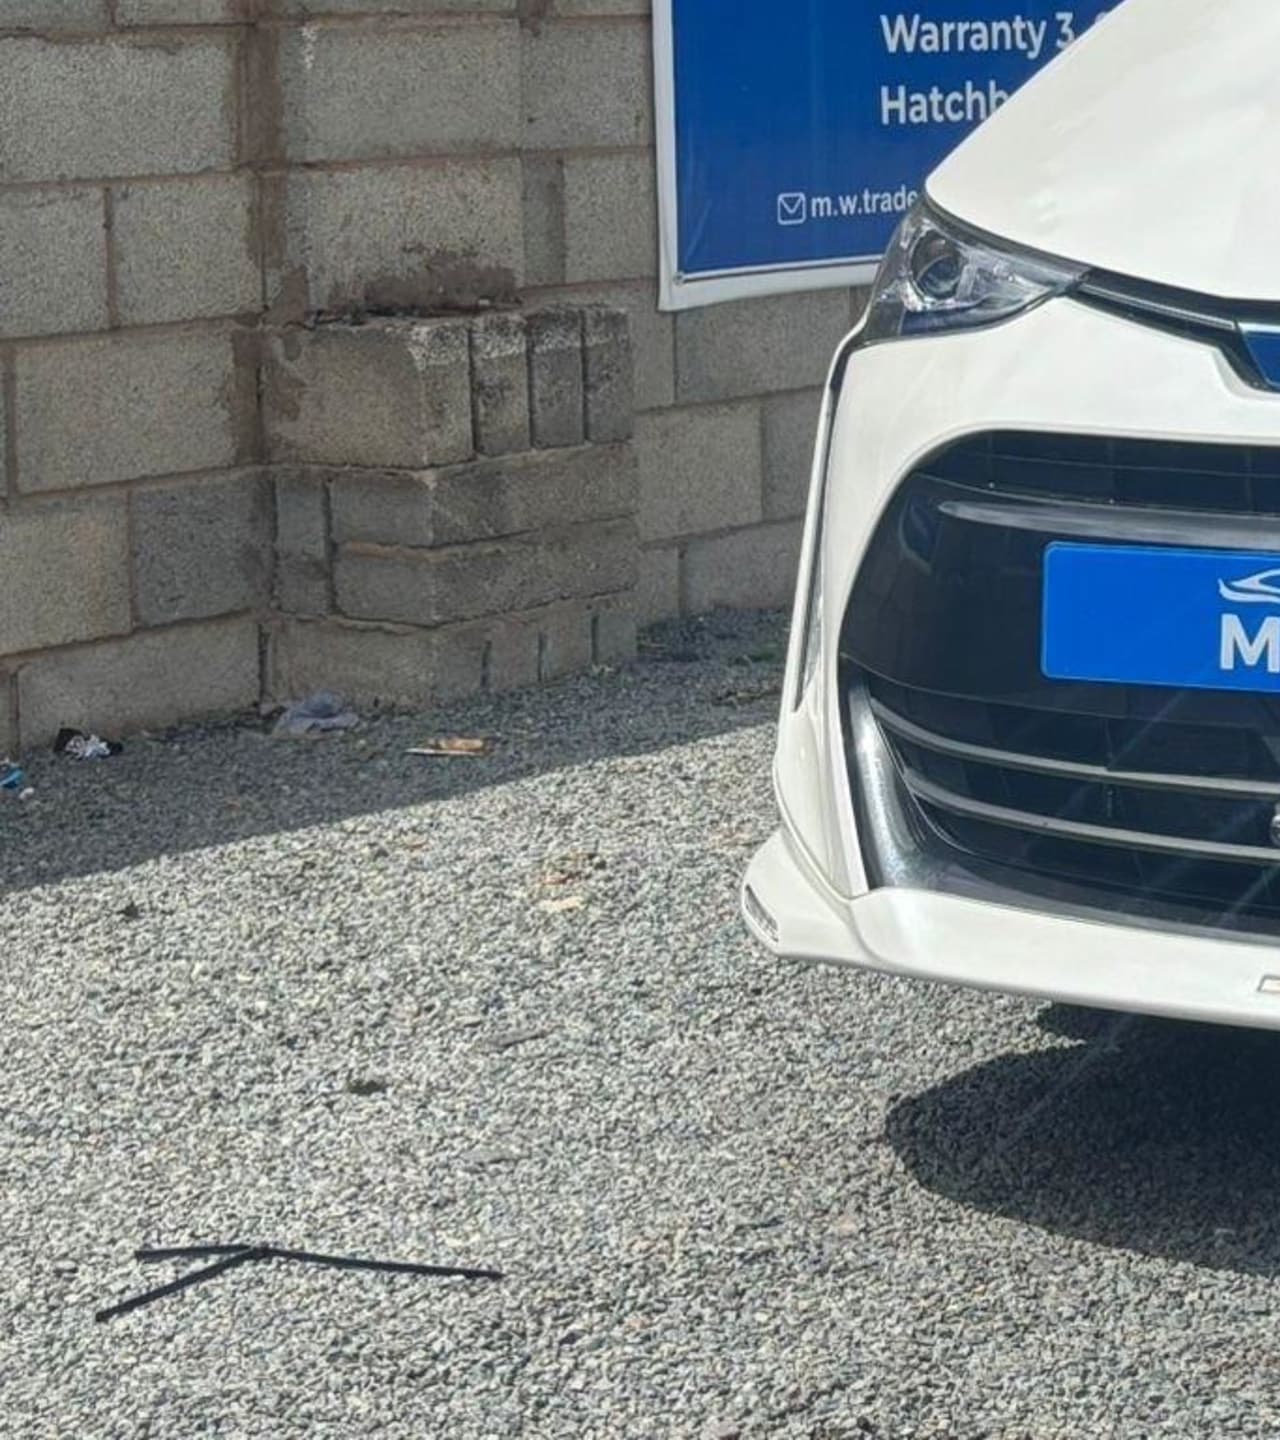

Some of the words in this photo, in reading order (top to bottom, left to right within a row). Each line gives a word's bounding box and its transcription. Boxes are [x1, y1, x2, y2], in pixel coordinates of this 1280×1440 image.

[879, 13, 1047, 61] Warranty
[1055, 11, 1076, 50] 3
[880, 79, 1010, 125] Hatchb
[811, 184, 919, 218] m.w.trade
